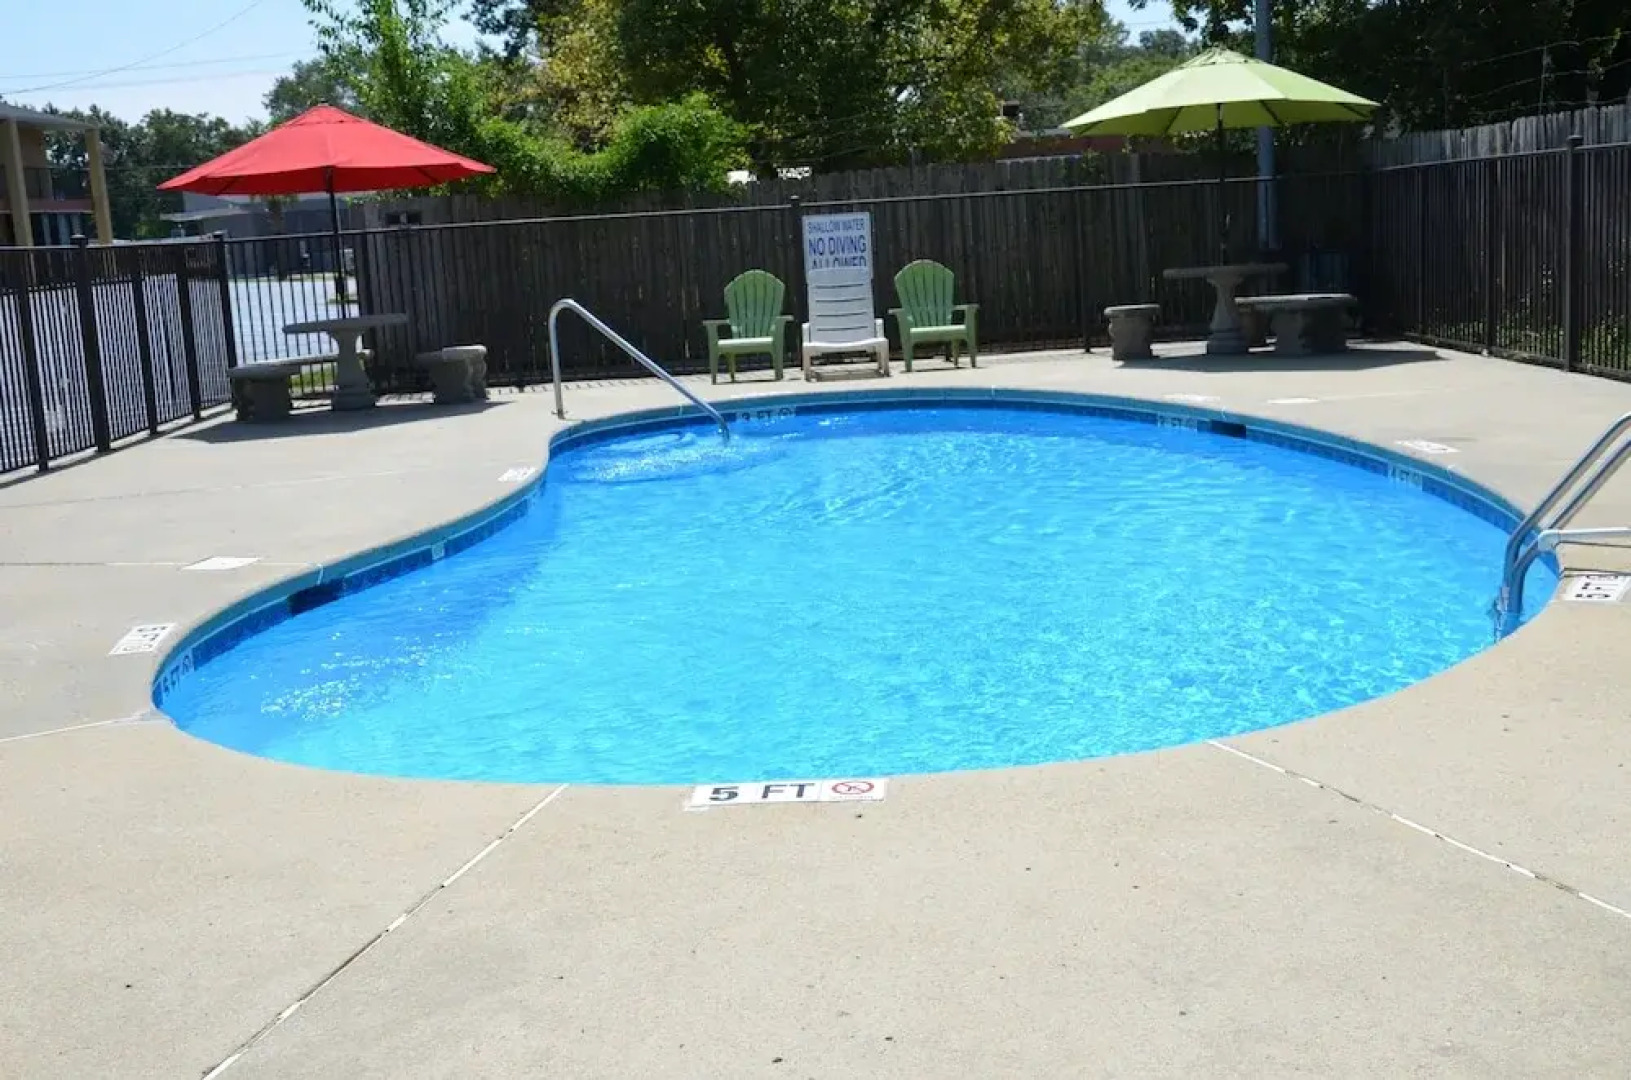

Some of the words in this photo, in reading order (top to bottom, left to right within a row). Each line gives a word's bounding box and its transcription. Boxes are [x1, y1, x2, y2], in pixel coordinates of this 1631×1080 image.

[808, 220, 840, 234] SHALLOW
[841, 219, 865, 231] WATER
[808, 238, 825, 256] NO
[829, 235, 867, 254] DIVING
[709, 786, 739, 801] 5
[761, 783, 815, 799] FT
